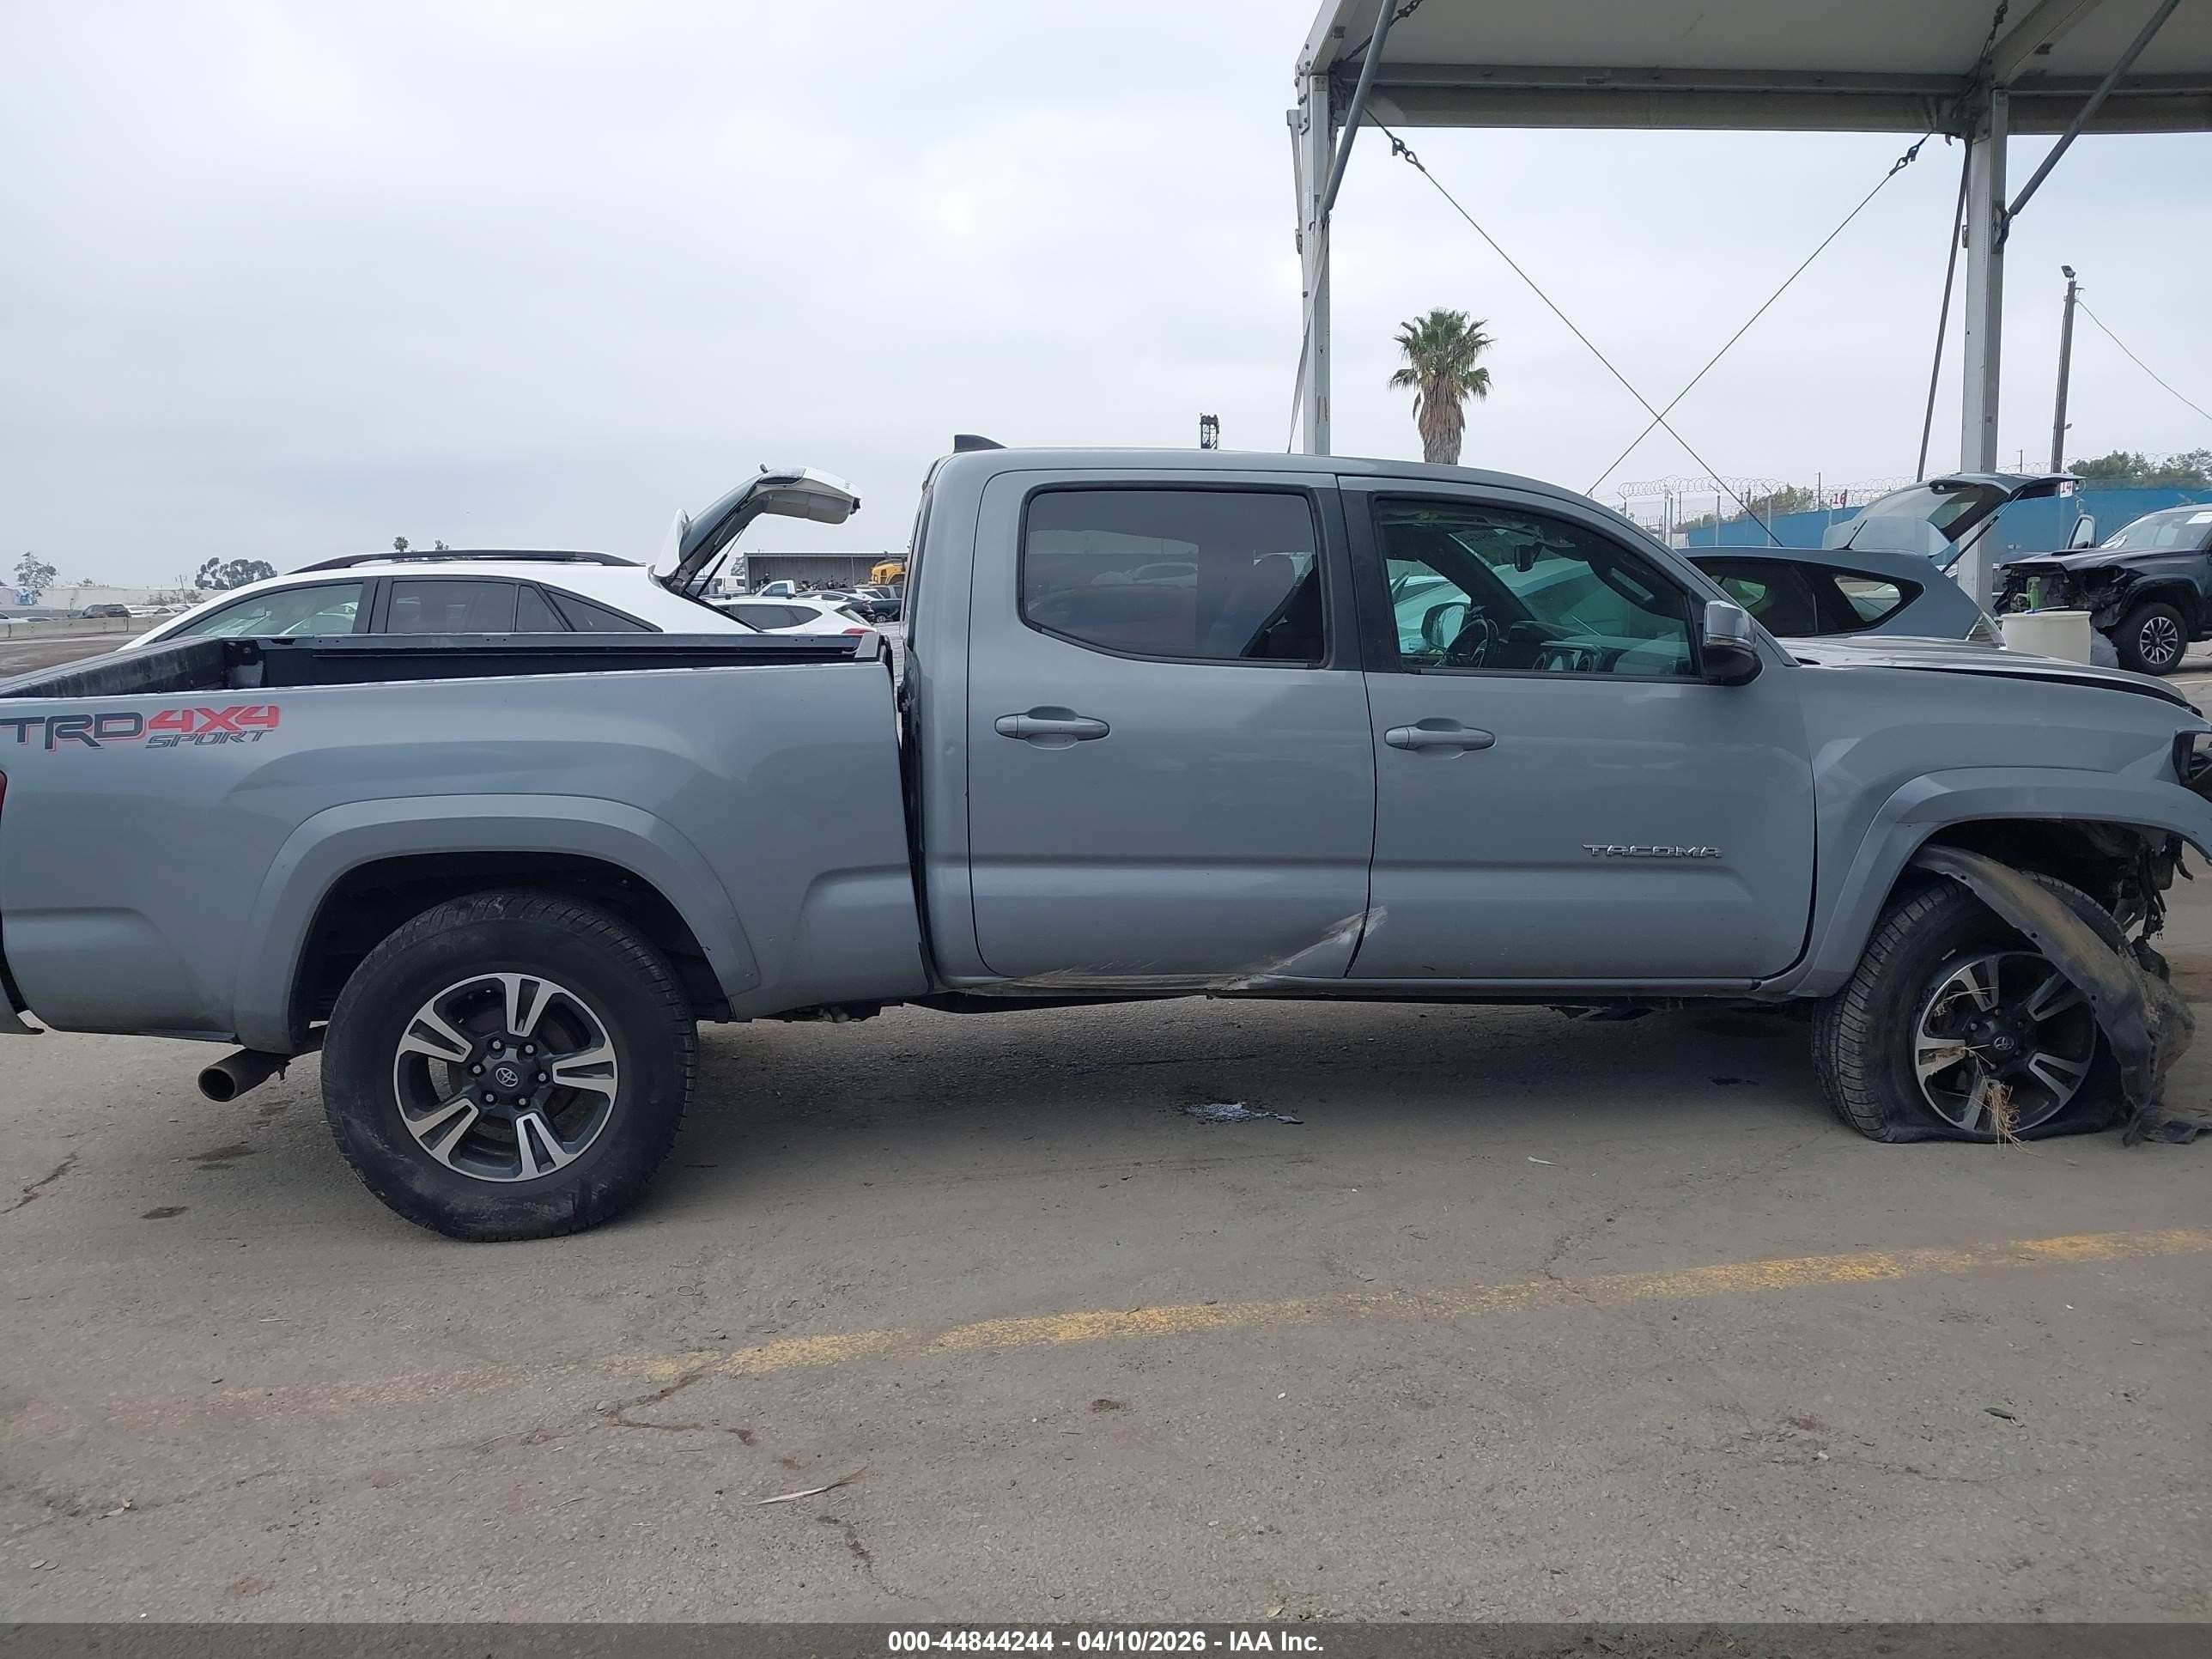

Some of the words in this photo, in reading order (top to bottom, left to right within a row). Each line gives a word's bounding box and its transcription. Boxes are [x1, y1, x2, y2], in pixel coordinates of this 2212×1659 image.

[0, 712, 145, 751] TRD
[145, 729, 274, 749] SPORT
[1582, 844, 1723, 858] TACOMA
